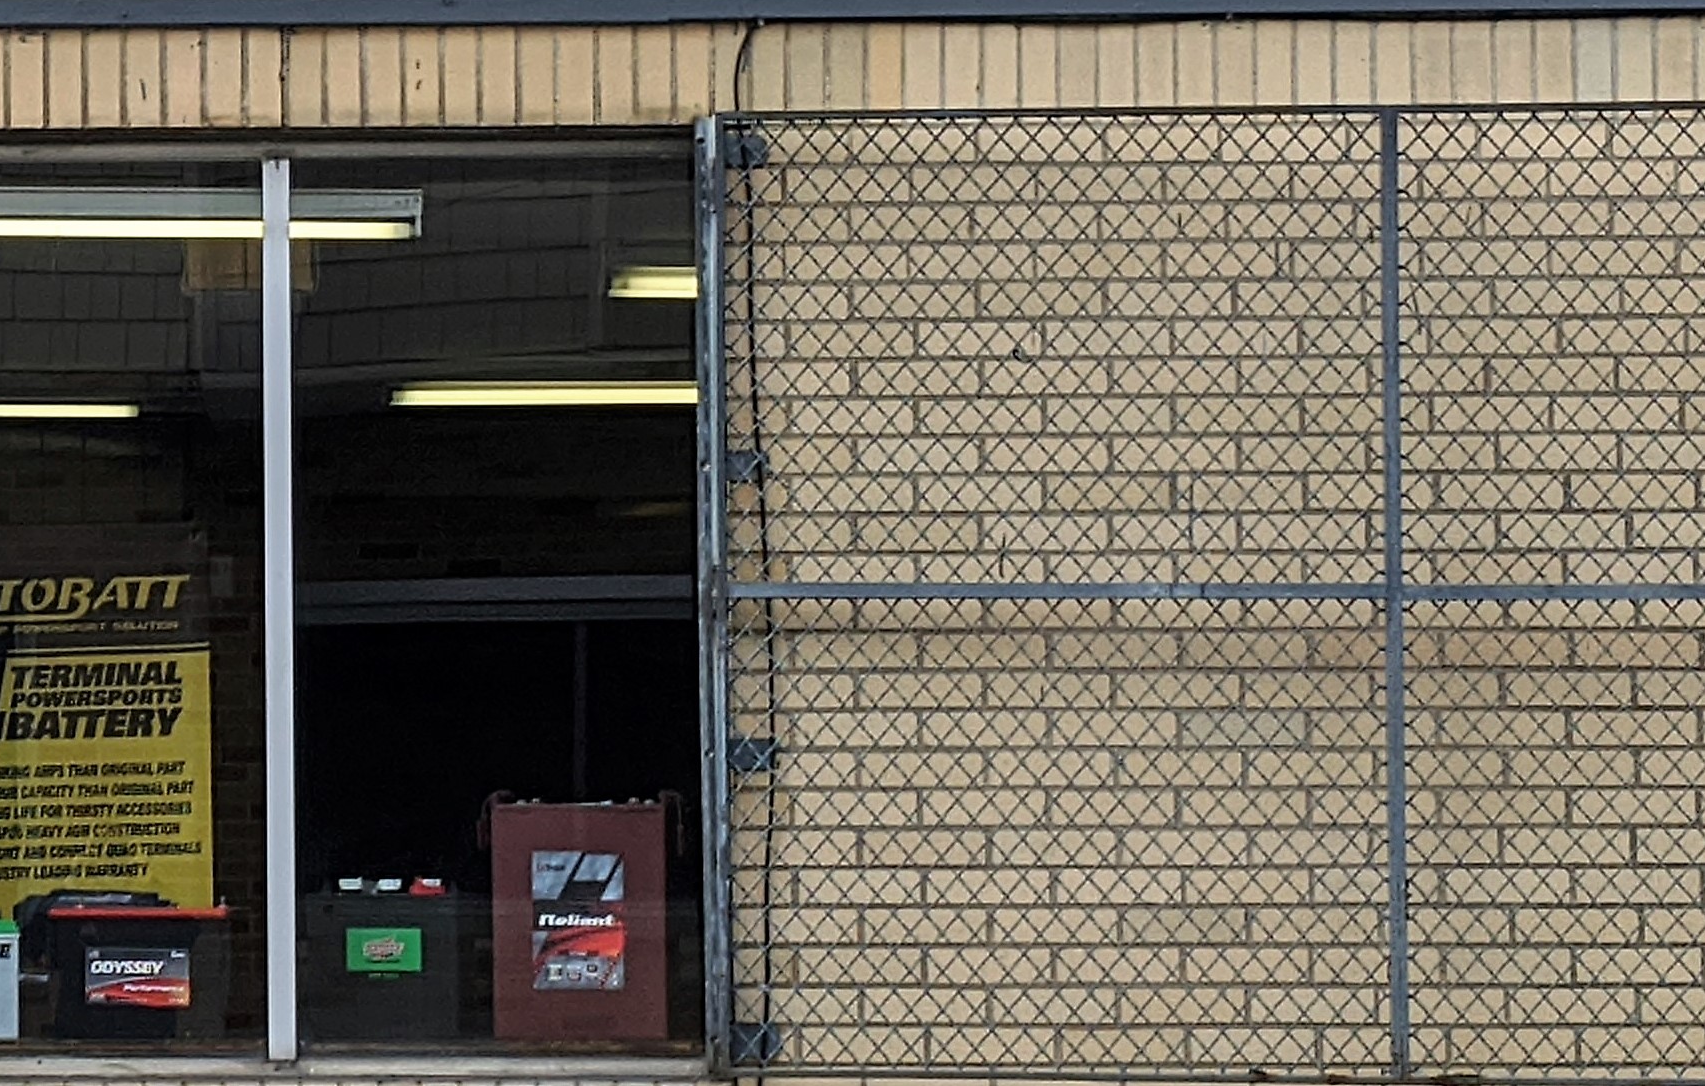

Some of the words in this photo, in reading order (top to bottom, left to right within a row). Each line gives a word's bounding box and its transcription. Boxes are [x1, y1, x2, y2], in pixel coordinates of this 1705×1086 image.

[11, 660, 183, 690] TERMINAL
[10, 687, 183, 709] POWERSPORTS
[4, 707, 183, 741] BATTERY
[166, 780, 193, 794] PART
[90, 959, 164, 975] ODYSSEY
